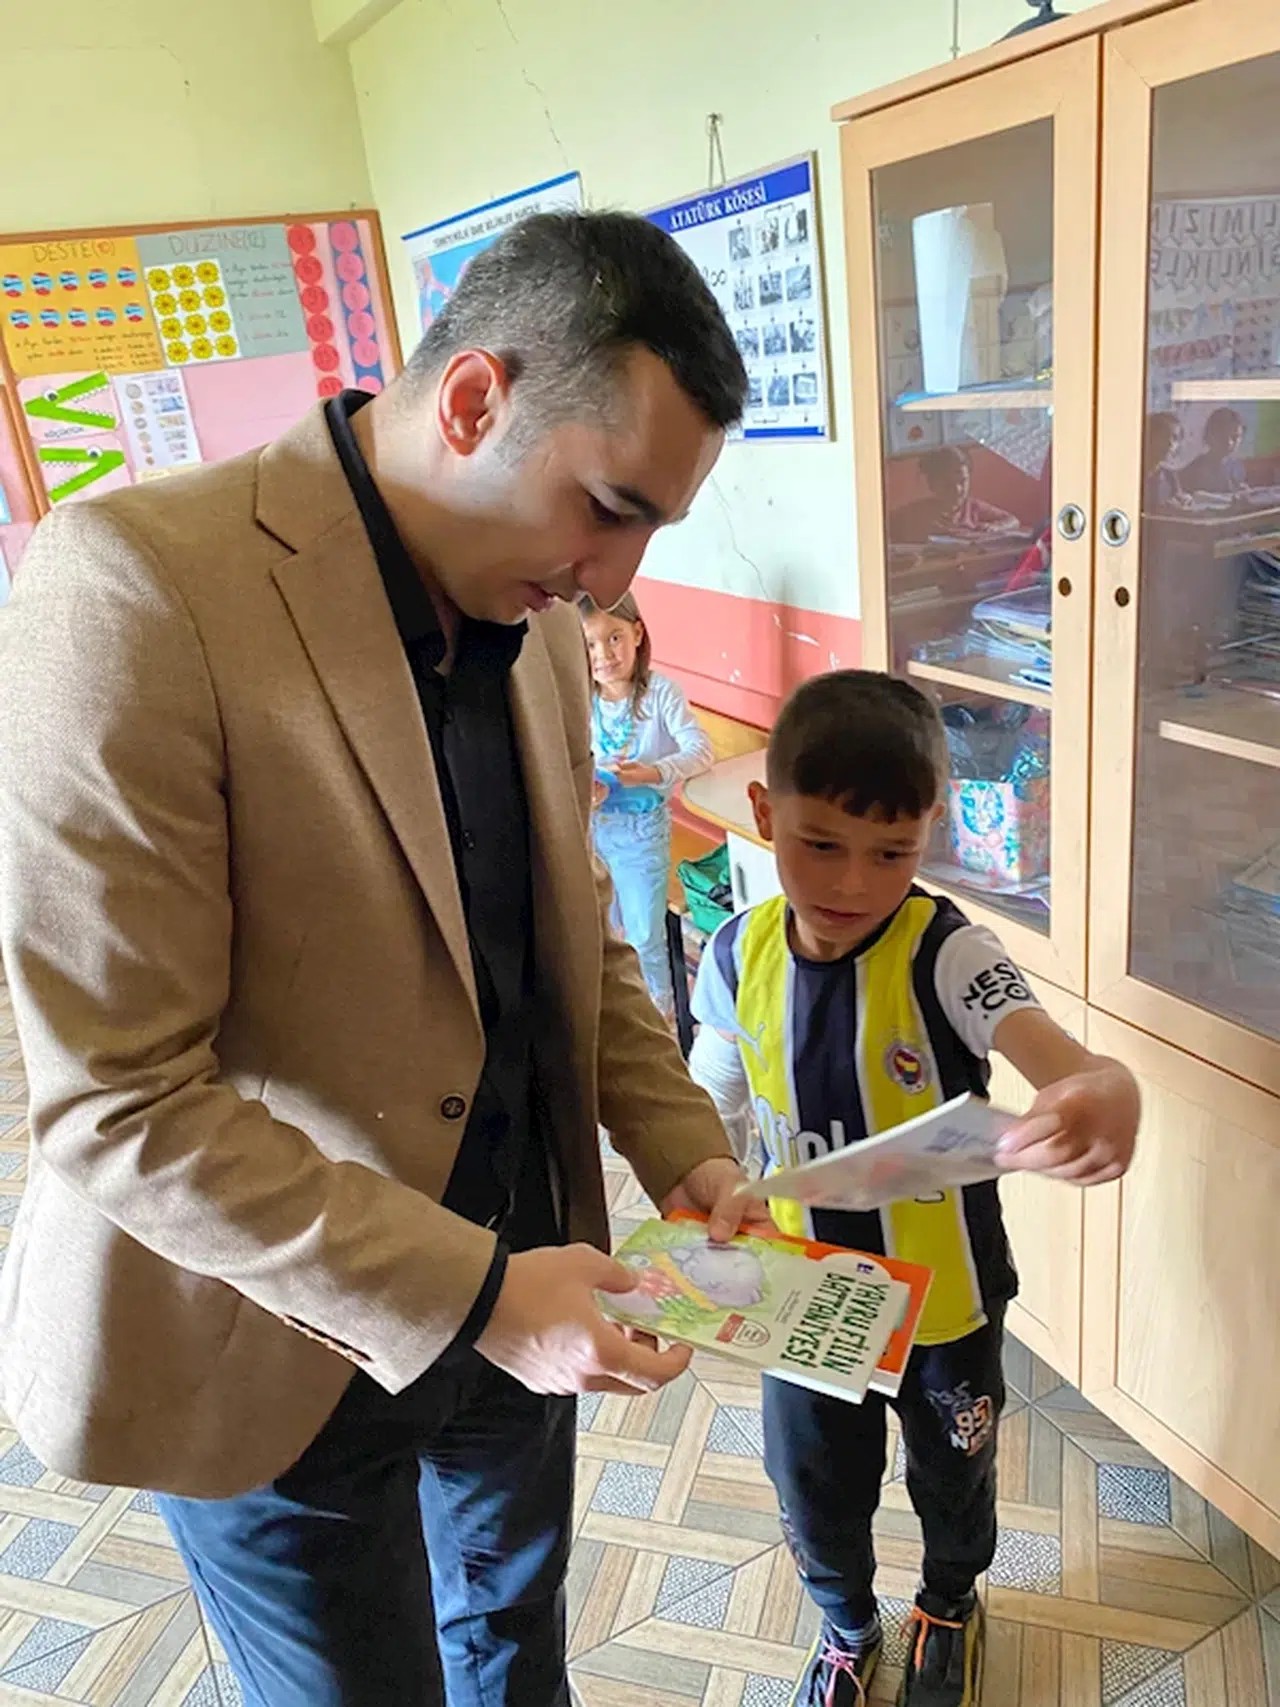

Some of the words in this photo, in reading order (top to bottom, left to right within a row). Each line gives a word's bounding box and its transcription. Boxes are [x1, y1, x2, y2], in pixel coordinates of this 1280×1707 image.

[670, 199, 723, 230] ATATÜRK
[724, 181, 767, 212] KÖŞESİ
[840, 1280, 891, 1331] YAVRU
[820, 1327, 871, 1375] FİLİN
